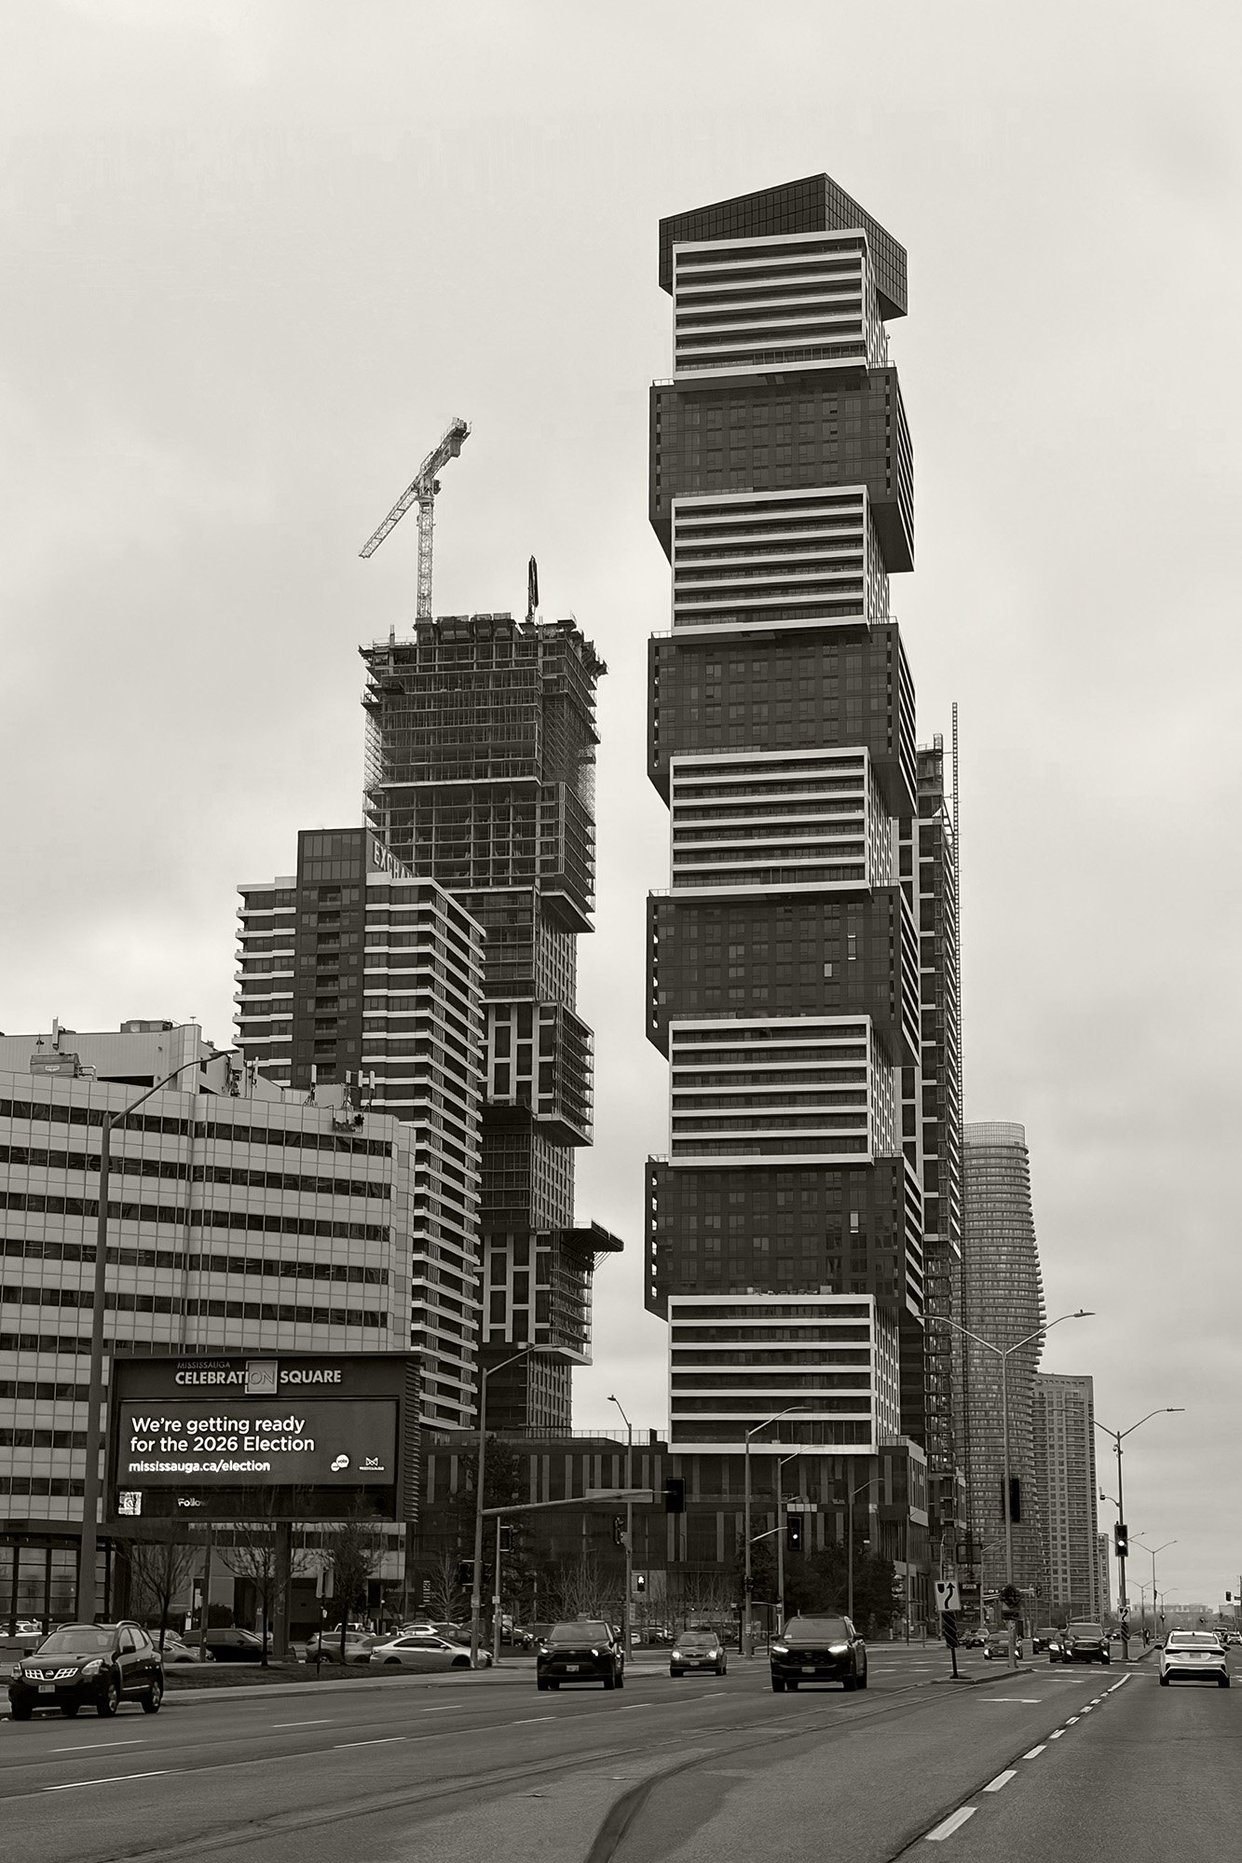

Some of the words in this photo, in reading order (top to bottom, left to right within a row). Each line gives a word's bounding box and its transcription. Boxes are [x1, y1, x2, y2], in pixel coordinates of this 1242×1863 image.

[177, 1361, 231, 1369] MISSISSAUGA
[175, 1370, 275, 1385] CELEBRATION
[280, 1370, 342, 1383] SQUARE
[131, 1417, 182, 1433] We're
[186, 1416, 250, 1434] getting
[255, 1416, 305, 1434] ready
[130, 1436, 156, 1452] for
[160, 1436, 189, 1452] the
[193, 1436, 238, 1452] 2026
[243, 1436, 315, 1452] Election
[128, 1459, 271, 1473] mississauga.ca/election
